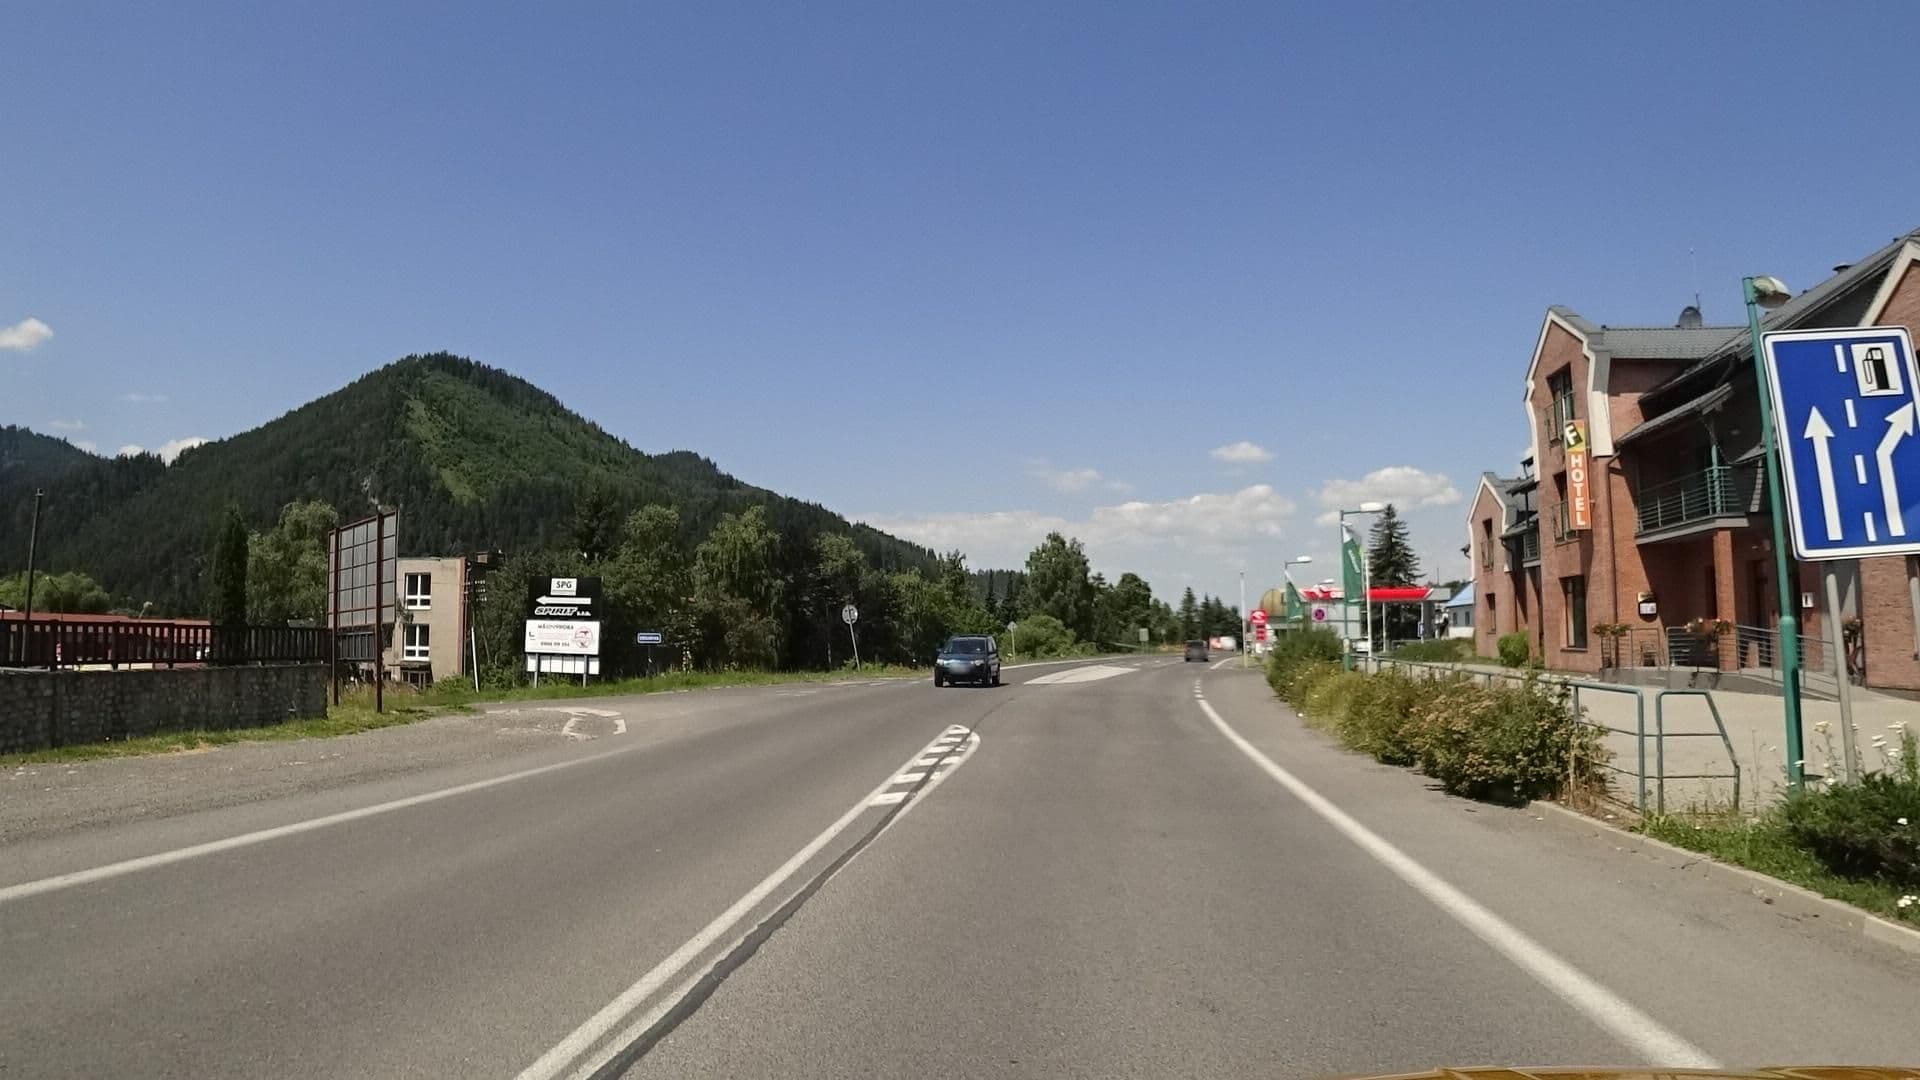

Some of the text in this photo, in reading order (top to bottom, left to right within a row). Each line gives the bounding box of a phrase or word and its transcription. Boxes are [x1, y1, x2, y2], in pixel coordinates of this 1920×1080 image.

[1565, 424, 1579, 446] F
[1570, 454, 1586, 526] HOTEL
[556, 580, 572, 589] SPG
[534, 606, 578, 616] SPIRIT
